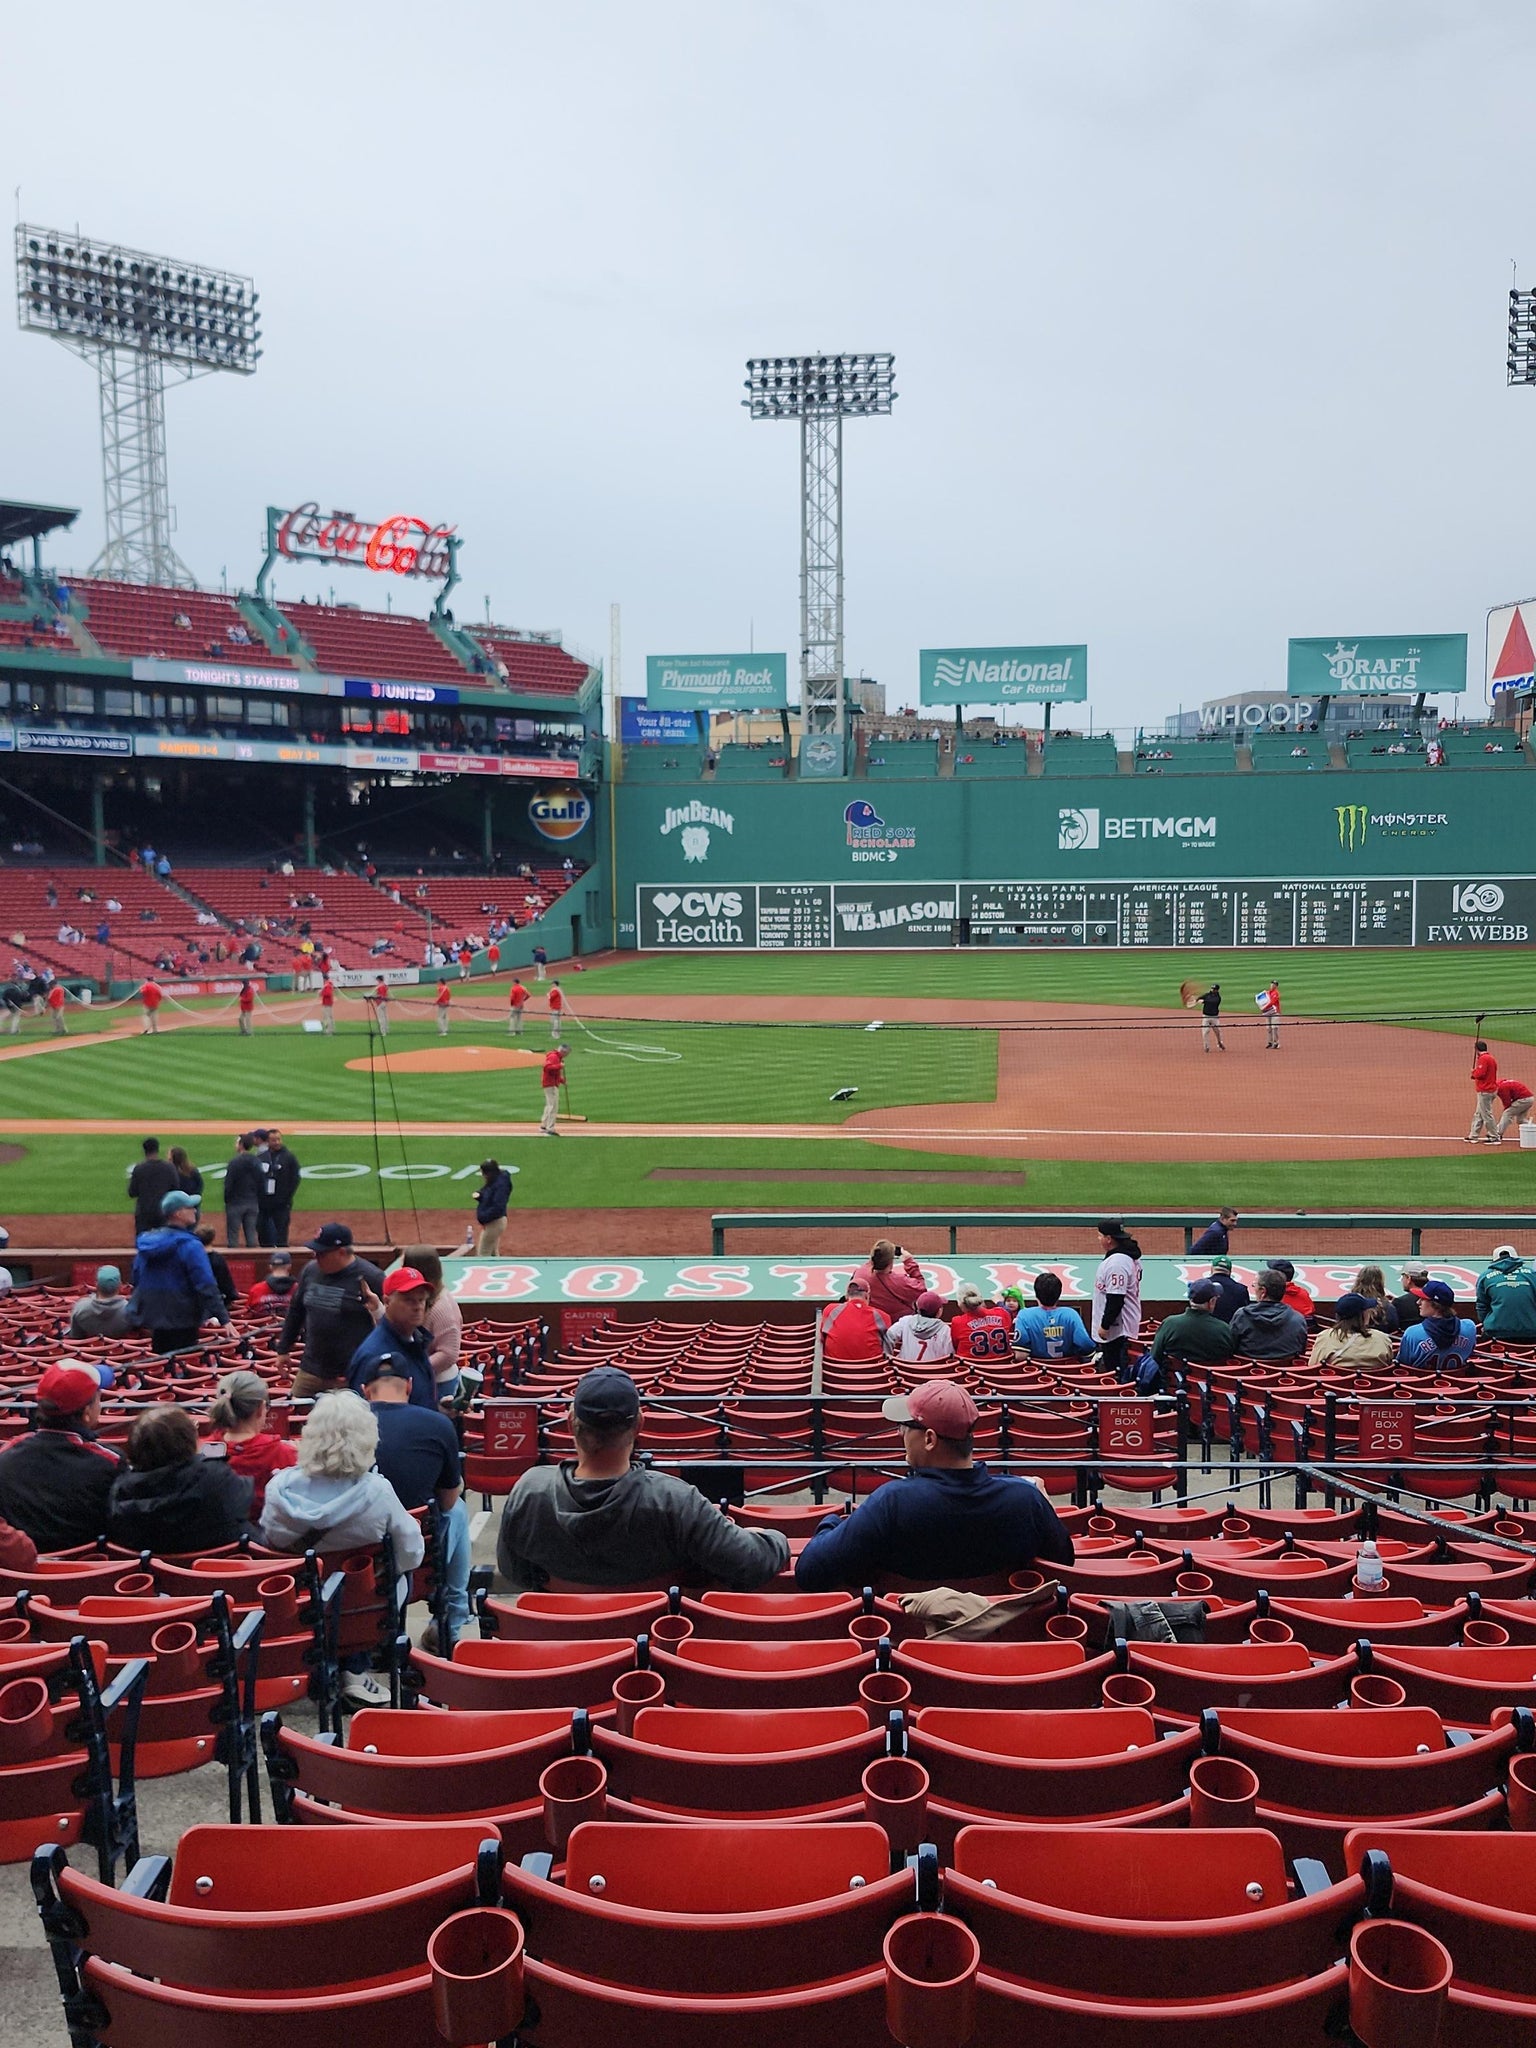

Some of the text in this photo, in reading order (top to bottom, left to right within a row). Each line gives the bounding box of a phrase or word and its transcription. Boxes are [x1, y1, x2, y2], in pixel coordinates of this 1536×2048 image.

[965, 658, 1072, 683] National
[1329, 658, 1421, 678] DRAFT
[185, 668, 299, 690] TONIGHT'S STARTERS
[662, 668, 773, 688] Plymouth Rock
[1340, 675, 1417, 691] KINGS
[386, 684, 436, 701] UNITED
[1002, 683, 1067, 694] Car Rental
[636, 717, 657, 727] Your
[1198, 702, 1312, 728] WHOOP
[31, 735, 128, 750] VINEYARD VINES
[239, 747, 253, 757] VS
[530, 801, 586, 819] Gulf
[1371, 812, 1449, 827] MONSTER
[852, 827, 916, 838] RED SOX
[1105, 817, 1216, 838] BETMGM
[852, 838, 916, 848] SCHOLARS
[852, 852, 886, 862] BIDMC
[989, 885, 1042, 893] FENWAY
[1281, 883, 1327, 891] NATIONAL
[1222, 891, 1228, 899] R
[1452, 883, 1505, 913] 160
[681, 891, 743, 917] CVS
[836, 902, 873, 913] WHO BUT
[980, 911, 1005, 919] BOSTON
[619, 923, 635, 933] 310
[656, 919, 744, 943] Health
[981, 927, 993, 935] BAT
[1023, 926, 1048, 934] STRIKE
[1050, 926, 1066, 934] OUT
[1427, 925, 1529, 941] F.W. WEBB
[1111, 1273, 1125, 1287] 58
[969, 1327, 1009, 1356] 33
[917, 1340, 929, 1361] 7
[495, 1411, 527, 1419] FIELD
[1371, 1411, 1404, 1419] FIELD
[499, 1421, 522, 1429] BOX
[1375, 1421, 1399, 1429] BOX
[494, 1433, 527, 1450] 27
[1109, 1430, 1143, 1447] 26
[1370, 1433, 1403, 1450] 25
